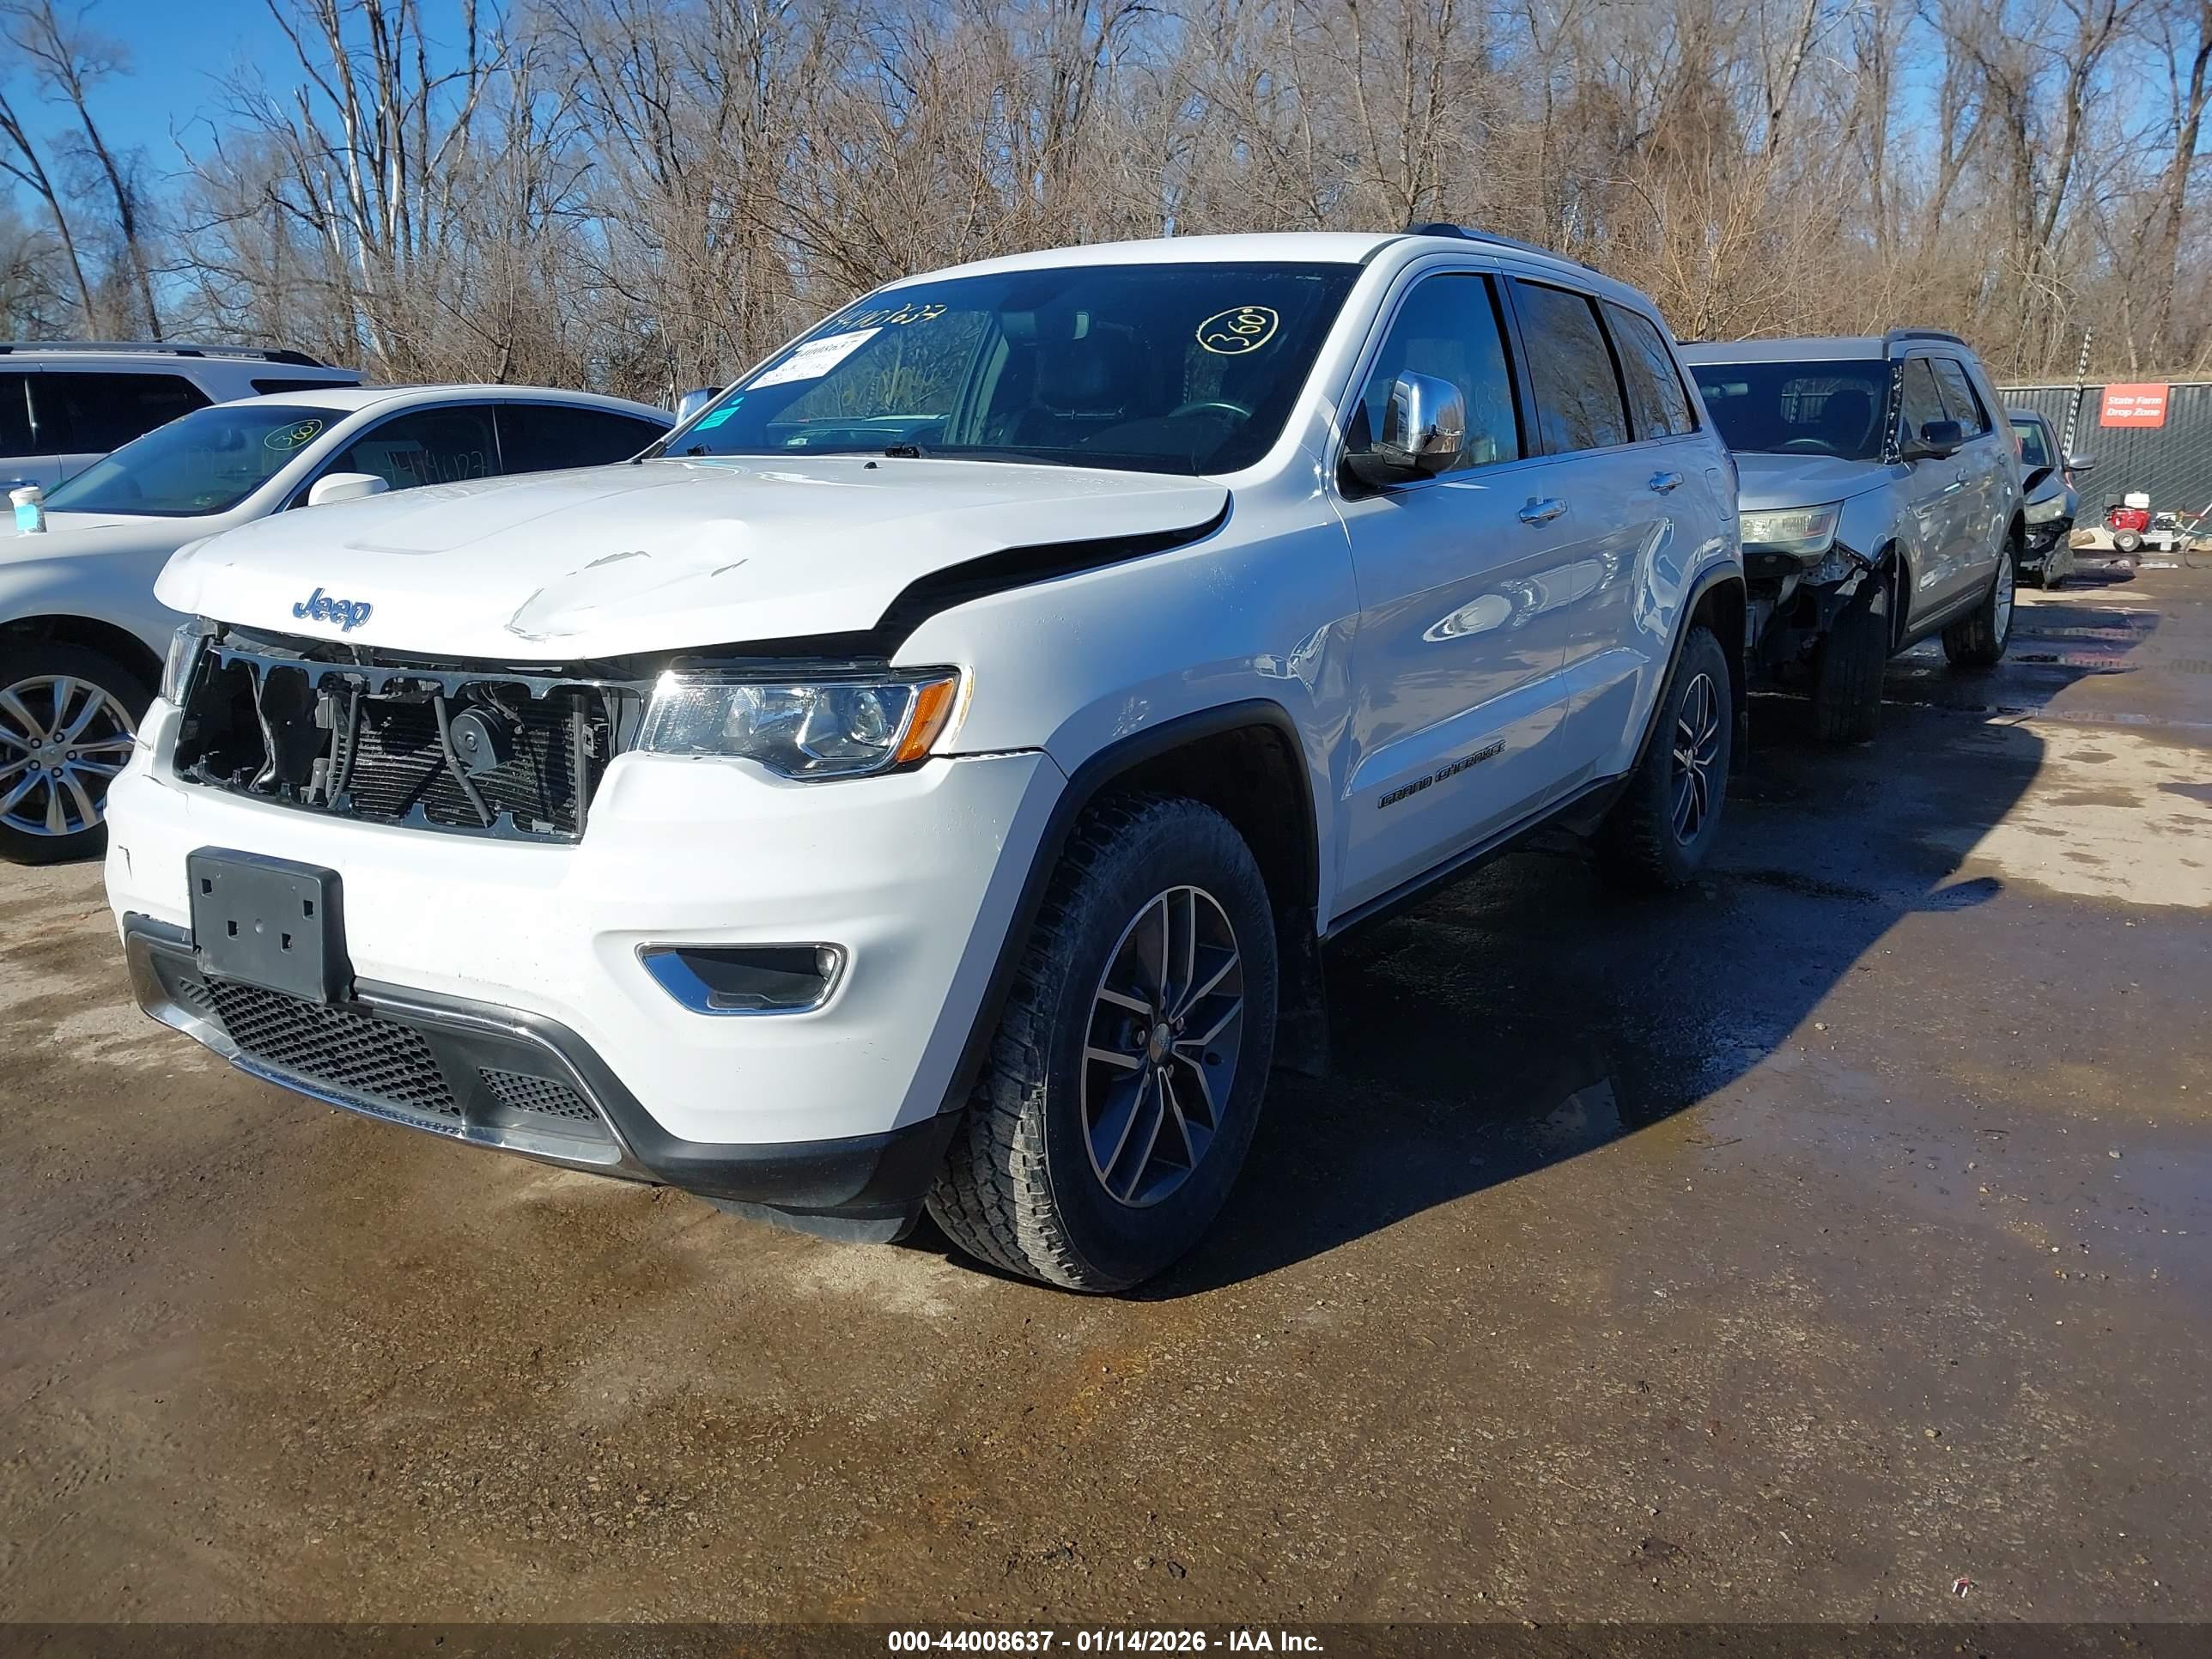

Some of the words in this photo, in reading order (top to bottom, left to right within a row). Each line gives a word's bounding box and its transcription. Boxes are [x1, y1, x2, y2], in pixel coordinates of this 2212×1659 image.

[2106, 396, 2135, 405] State
[2136, 396, 2163, 405] Farm
[2106, 407, 2133, 418] Drop
[2132, 407, 2161, 417] Zone
[293, 587, 373, 633] Jeep
[1377, 775, 1433, 810] GRAND
[1435, 738, 1506, 783] CHEROKEE
